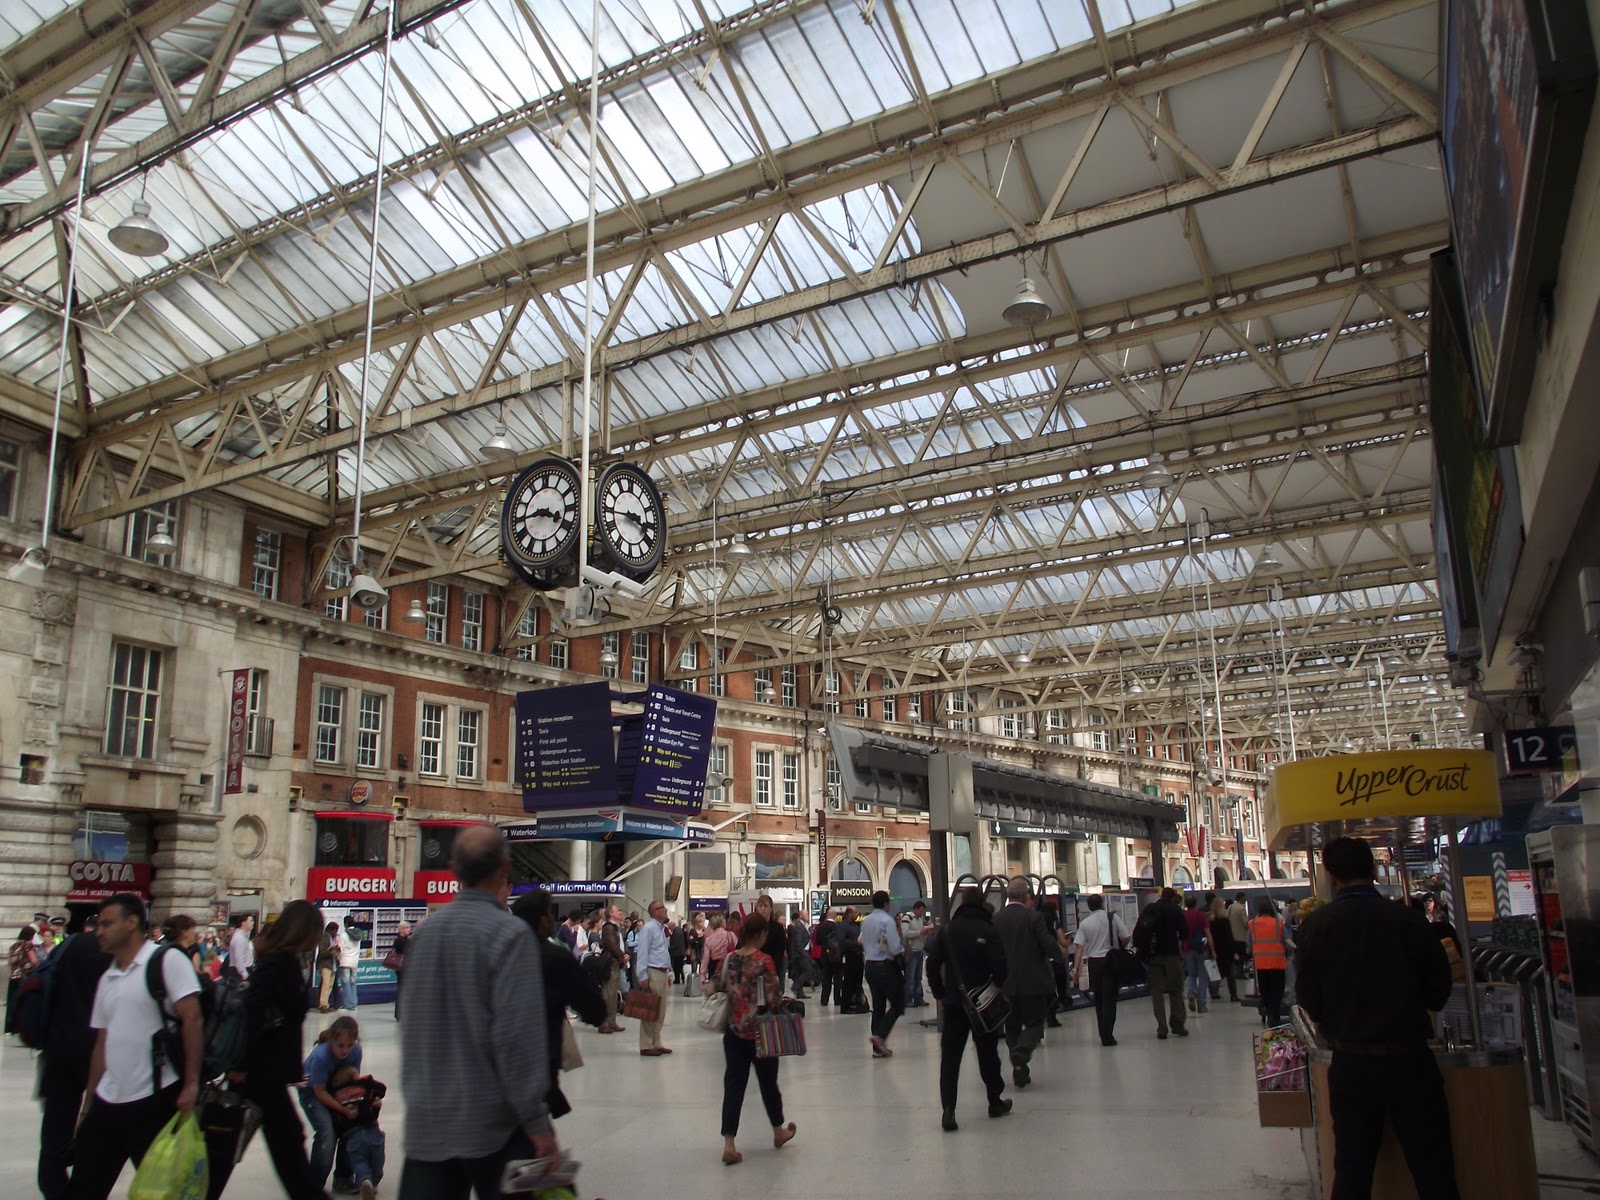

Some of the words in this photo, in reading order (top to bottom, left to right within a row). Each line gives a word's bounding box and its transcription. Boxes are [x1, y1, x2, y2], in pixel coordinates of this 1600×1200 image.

[228, 698, 244, 787] COSTA
[556, 737, 568, 745] point
[658, 736, 671, 745] London
[539, 747, 567, 756] Underground
[656, 747, 665, 755] Way
[1512, 736, 1548, 763] 12
[654, 758, 663, 766] Way
[1336, 764, 1414, 806] Upper
[1404, 762, 1471, 797] Crust
[656, 785, 671, 793] Waterloo
[678, 788, 690, 796] Station
[674, 798, 682, 806] Way
[539, 823, 559, 831] Welcome
[565, 821, 587, 829] Waterloo
[587, 820, 605, 828] Station
[625, 819, 641, 828] Welcome
[646, 822, 662, 830] Waterloo
[662, 823, 675, 832] Station
[510, 828, 537, 837] Waterloo
[818, 826, 826, 870] MONSOON
[70, 861, 135, 884] COSTA
[325, 877, 388, 893] BURGER
[427, 880, 463, 894] BUR
[557, 883, 606, 892] information
[836, 887, 871, 897] MONSOON
[329, 899, 360, 907] Information
